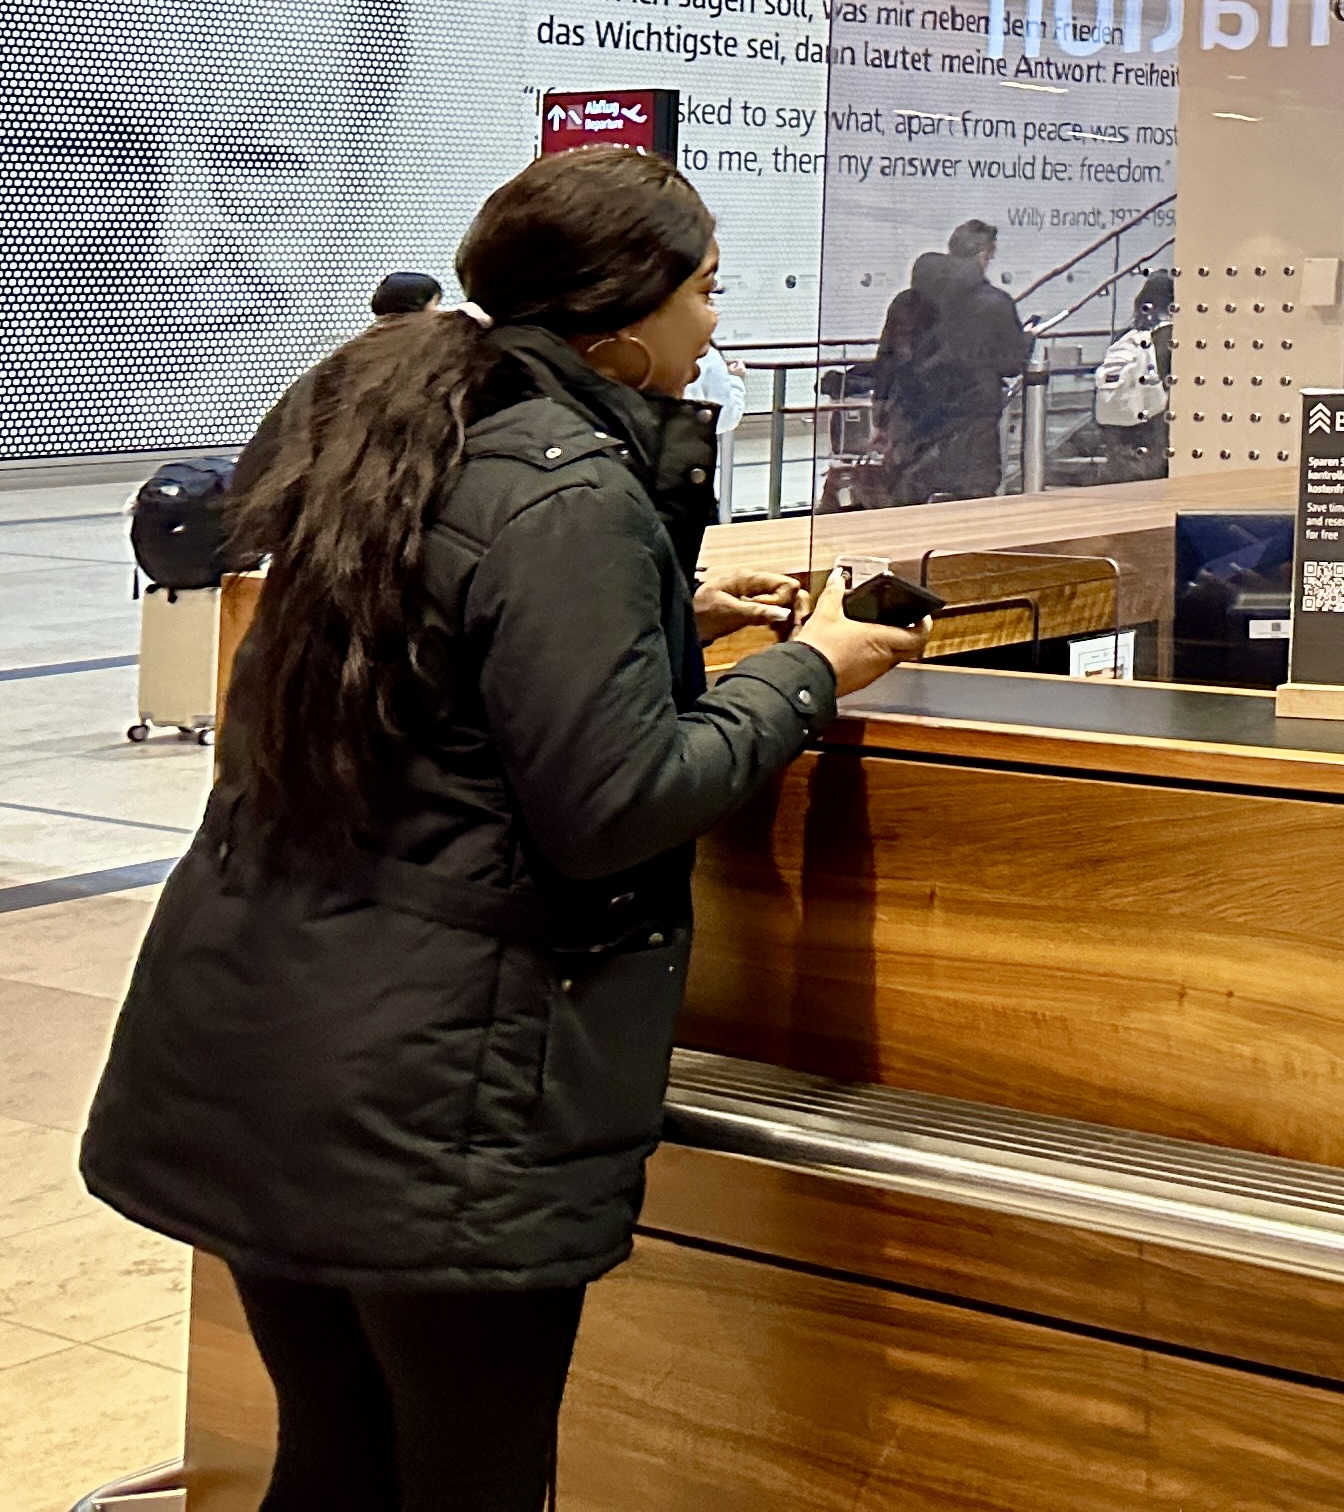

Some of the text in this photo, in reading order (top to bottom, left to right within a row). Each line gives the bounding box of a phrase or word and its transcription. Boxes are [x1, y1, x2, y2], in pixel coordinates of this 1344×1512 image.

[823, 0, 867, 23] was
[876, 1, 914, 27] mir
[921, 5, 990, 34] neben
[537, 15, 584, 46] das
[596, 19, 737, 62] Wichtigste
[747, 32, 786, 64] sei,
[864, 41, 932, 72] lautet
[942, 49, 1007, 76] meine
[1015, 54, 1107, 84] Antwort:
[584, 100, 620, 118] Abflug
[677, 95, 731, 126] sked
[742, 100, 766, 127] to
[775, 106, 816, 137] say
[825, 105, 885, 136] what,
[895, 110, 953, 141] apart
[962, 110, 1016, 138] from
[1091, 124, 1129, 144] was
[682, 144, 708, 170] to
[718, 152, 763, 176] me,
[773, 144, 827, 176] then
[838, 153, 872, 182] my
[880, 155, 962, 178] answer
[968, 155, 1035, 180] would
[1042, 155, 1073, 181] be:
[1007, 208, 1047, 232] Willy
[1308, 456, 1339, 468] Sparen
[1307, 502, 1327, 512] Save
[1306, 516, 1322, 526] and
[1306, 529, 1338, 540] for free
